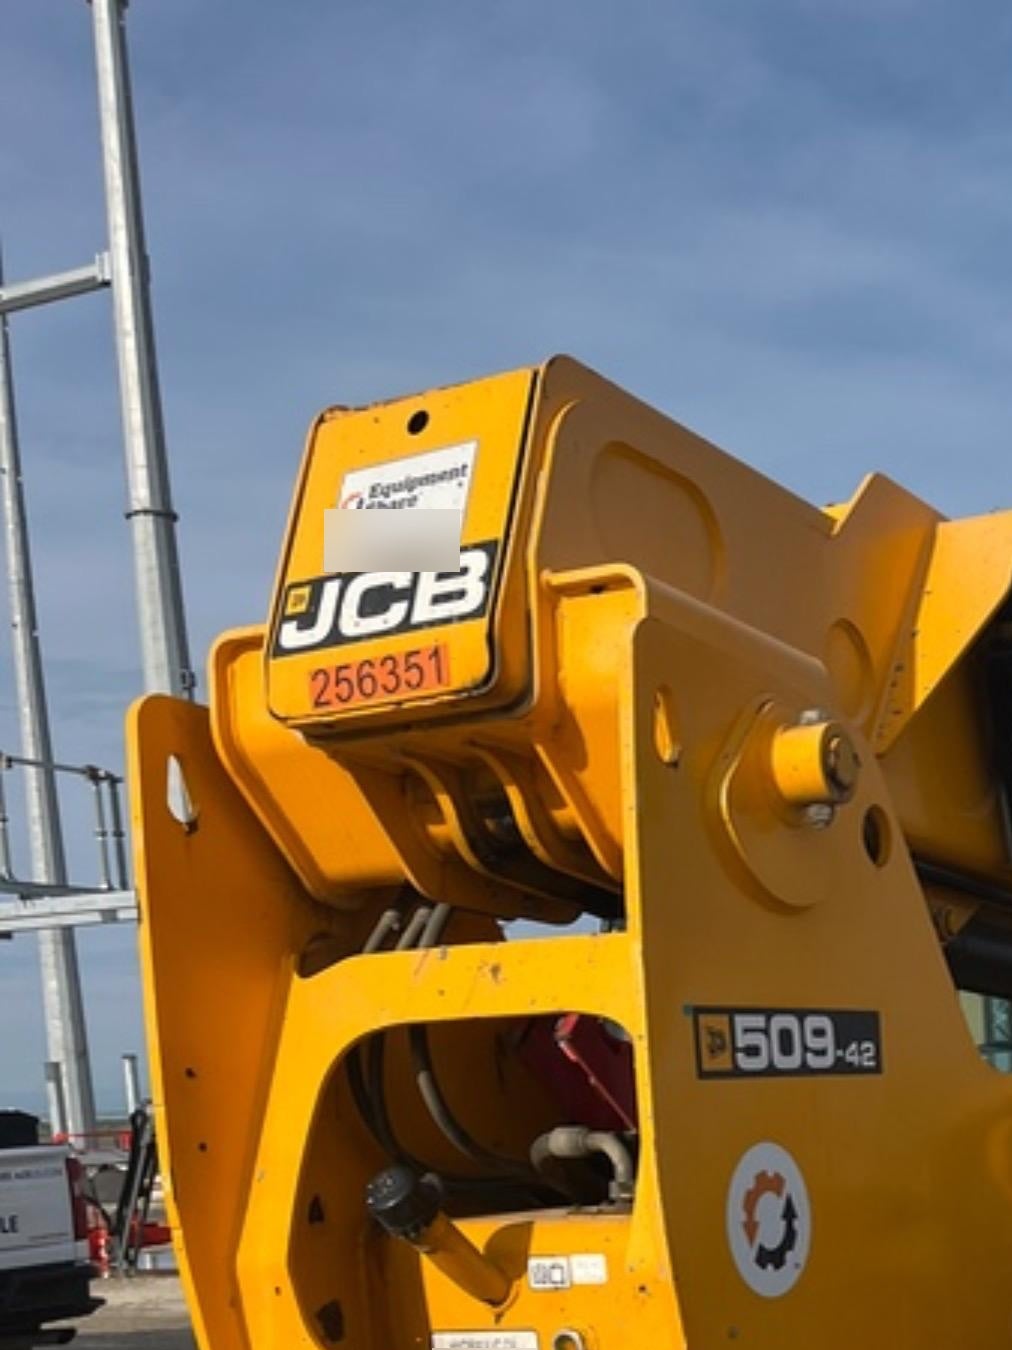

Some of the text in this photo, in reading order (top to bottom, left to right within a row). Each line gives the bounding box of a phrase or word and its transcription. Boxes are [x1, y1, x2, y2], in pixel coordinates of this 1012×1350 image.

[368, 464, 468, 499] Equipment
[279, 549, 488, 649] JCB
[310, 645, 445, 708] 256351
